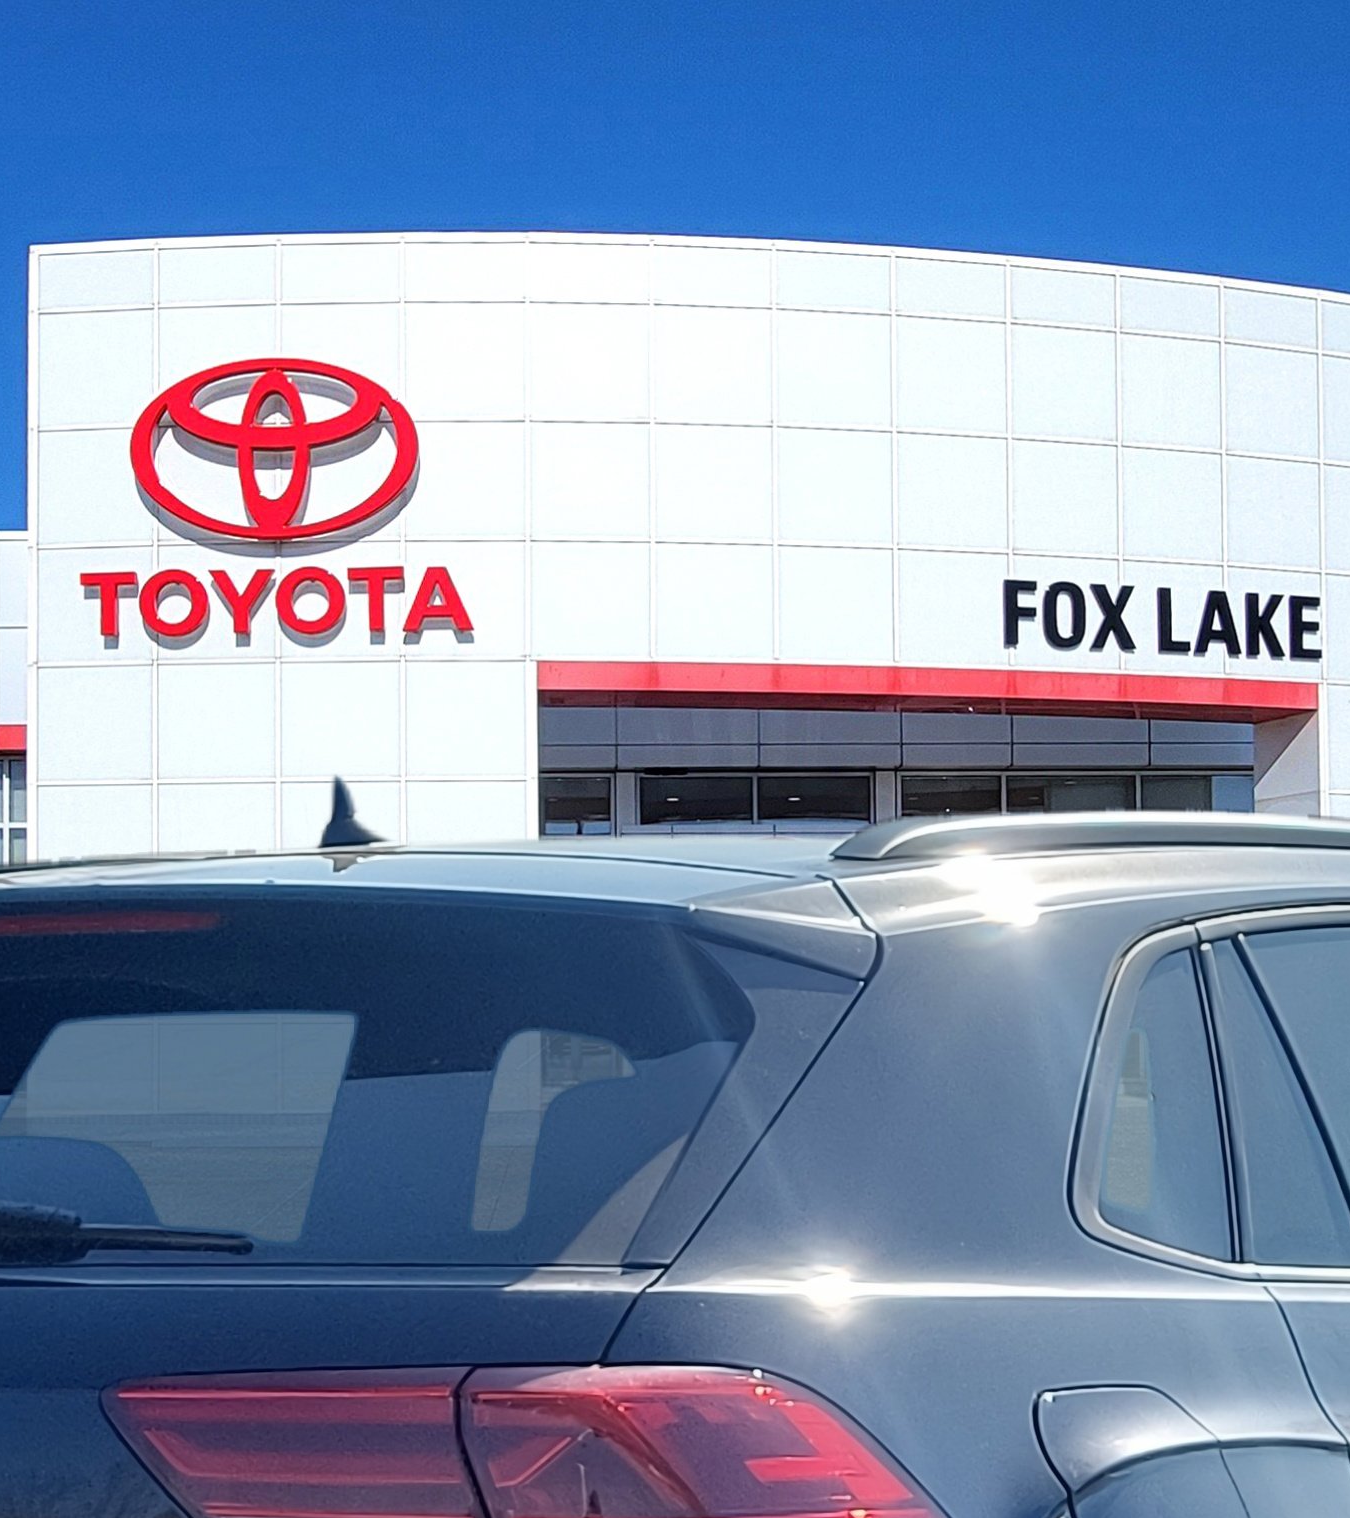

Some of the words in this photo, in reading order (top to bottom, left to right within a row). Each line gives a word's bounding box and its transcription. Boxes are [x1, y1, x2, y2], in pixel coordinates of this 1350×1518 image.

[80, 566, 475, 637] TOYOTA
[1003, 579, 1137, 652] FOX
[1156, 587, 1322, 660] LAKE
